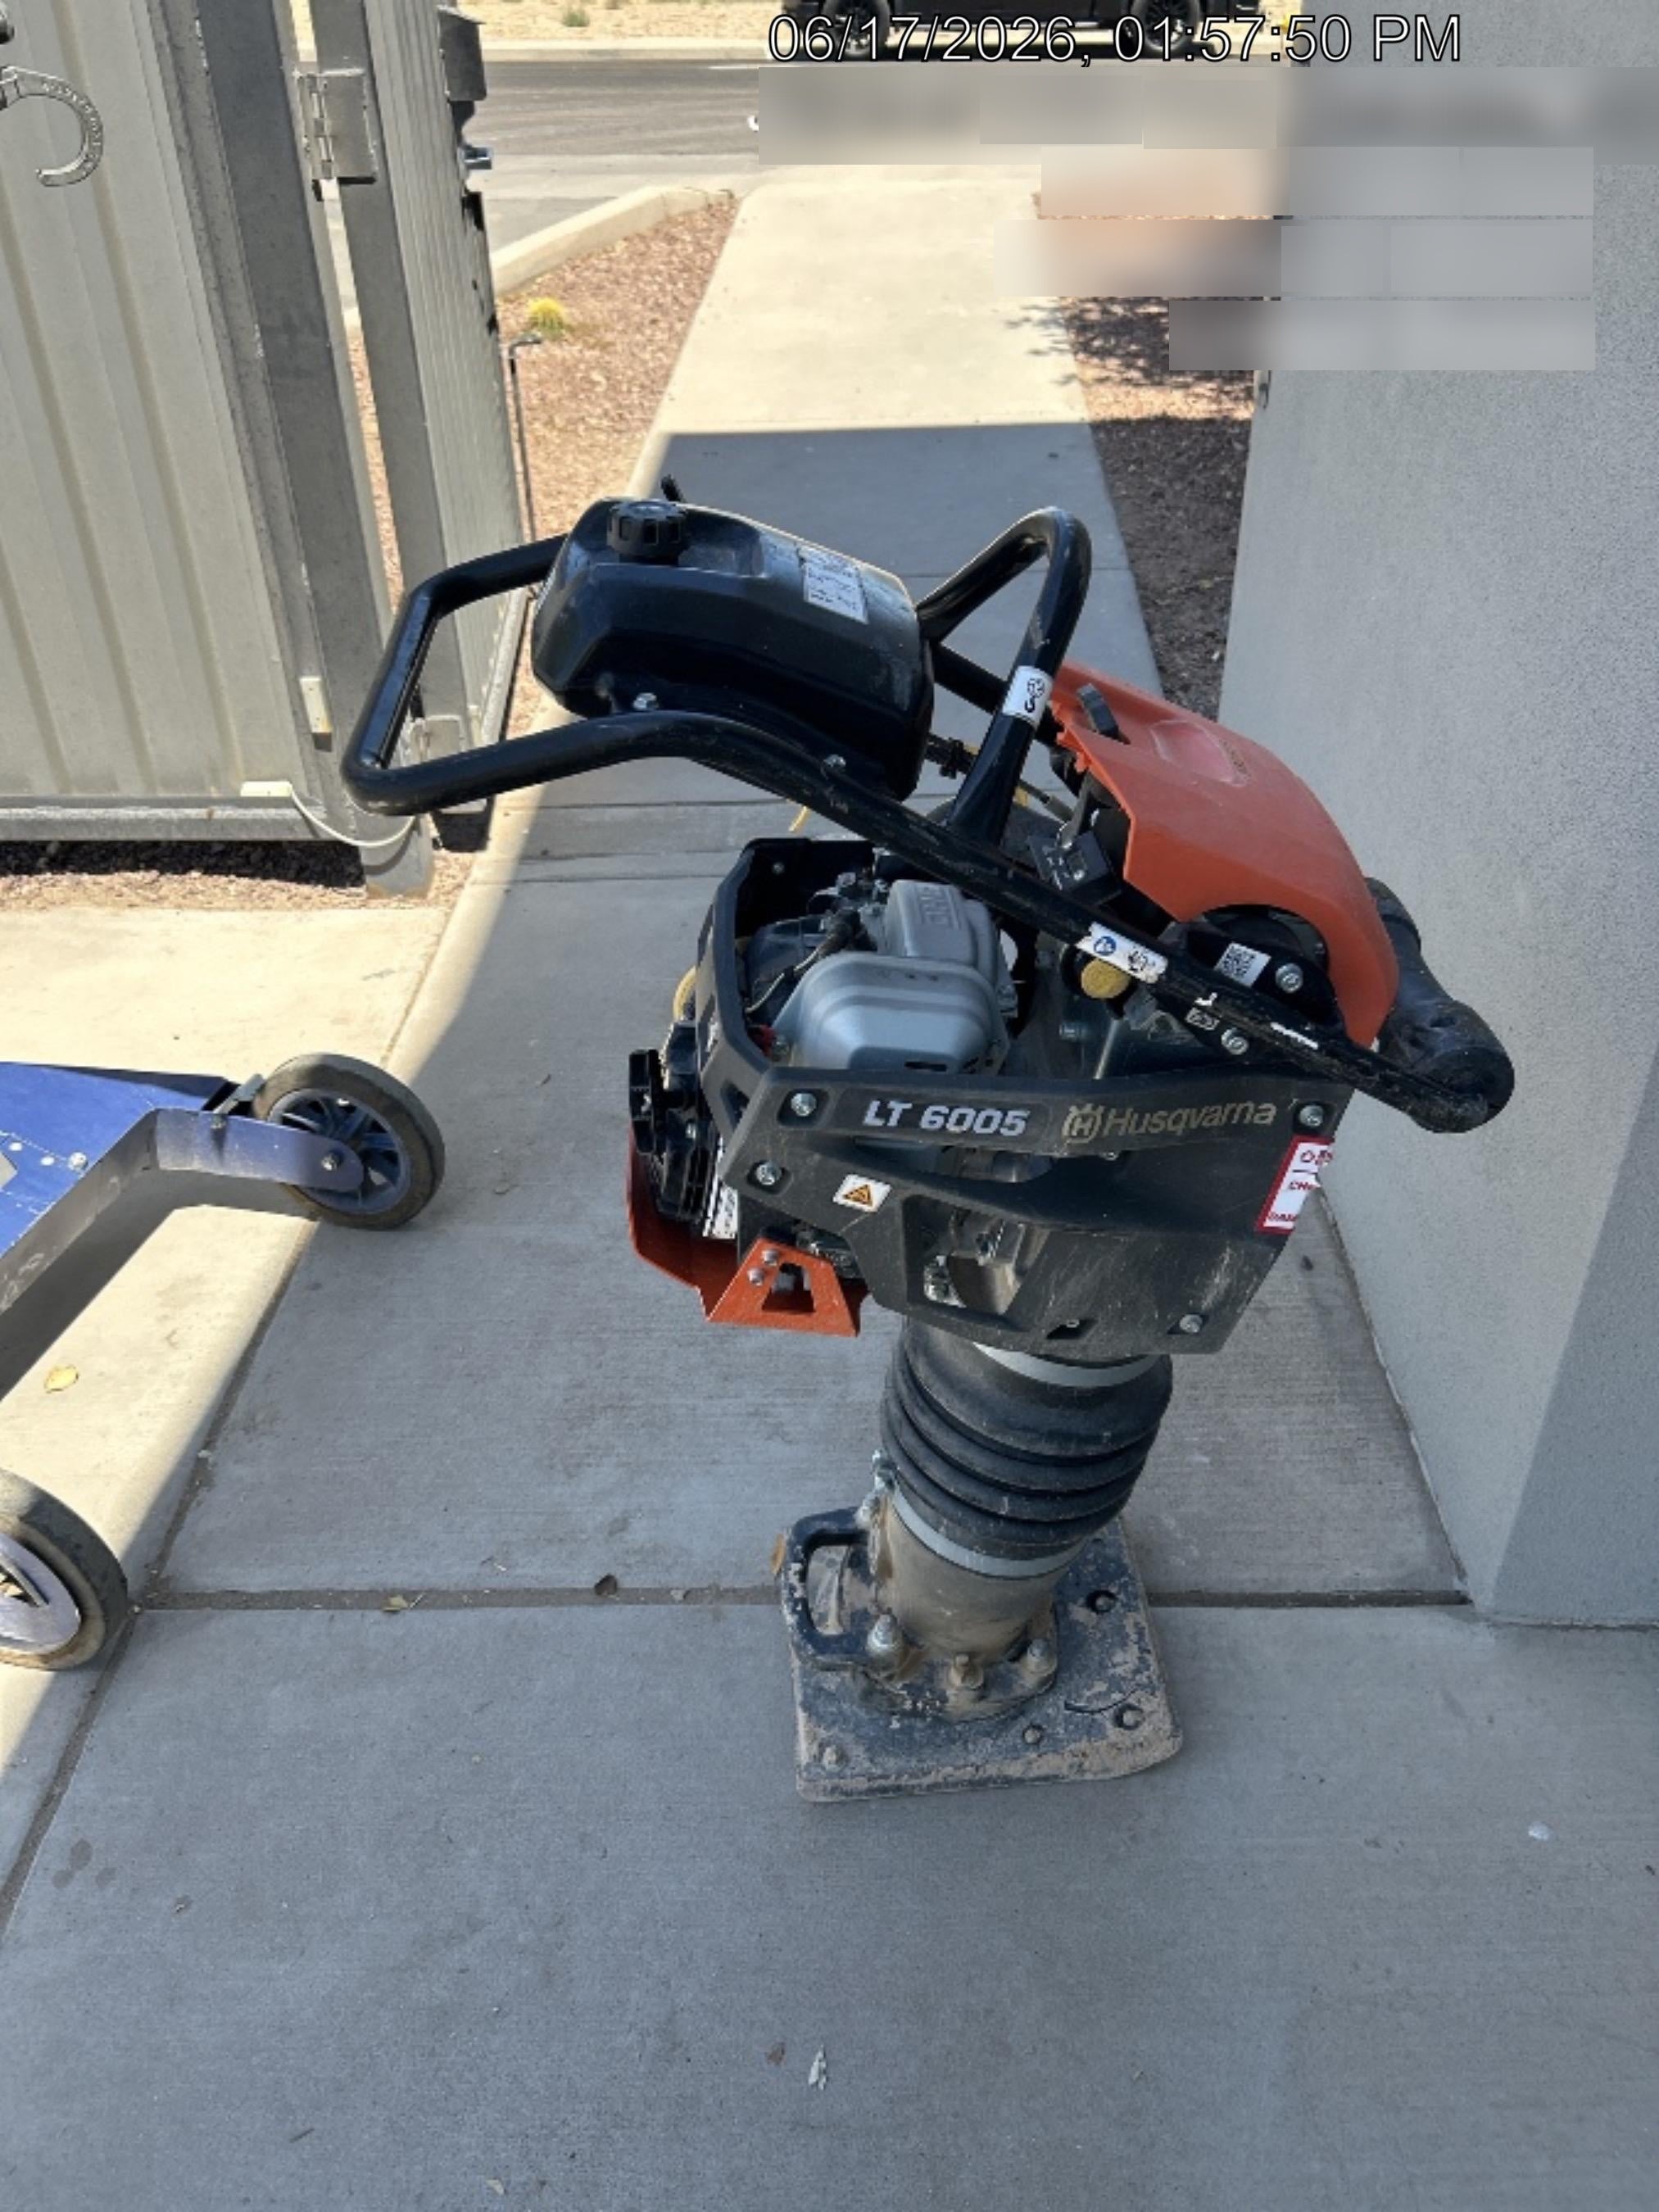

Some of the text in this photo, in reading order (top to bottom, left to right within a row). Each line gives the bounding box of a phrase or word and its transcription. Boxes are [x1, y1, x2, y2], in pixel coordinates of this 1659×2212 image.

[863, 1100, 1031, 1136] LT 6005
[1104, 1100, 1276, 1135] Husqvarna
